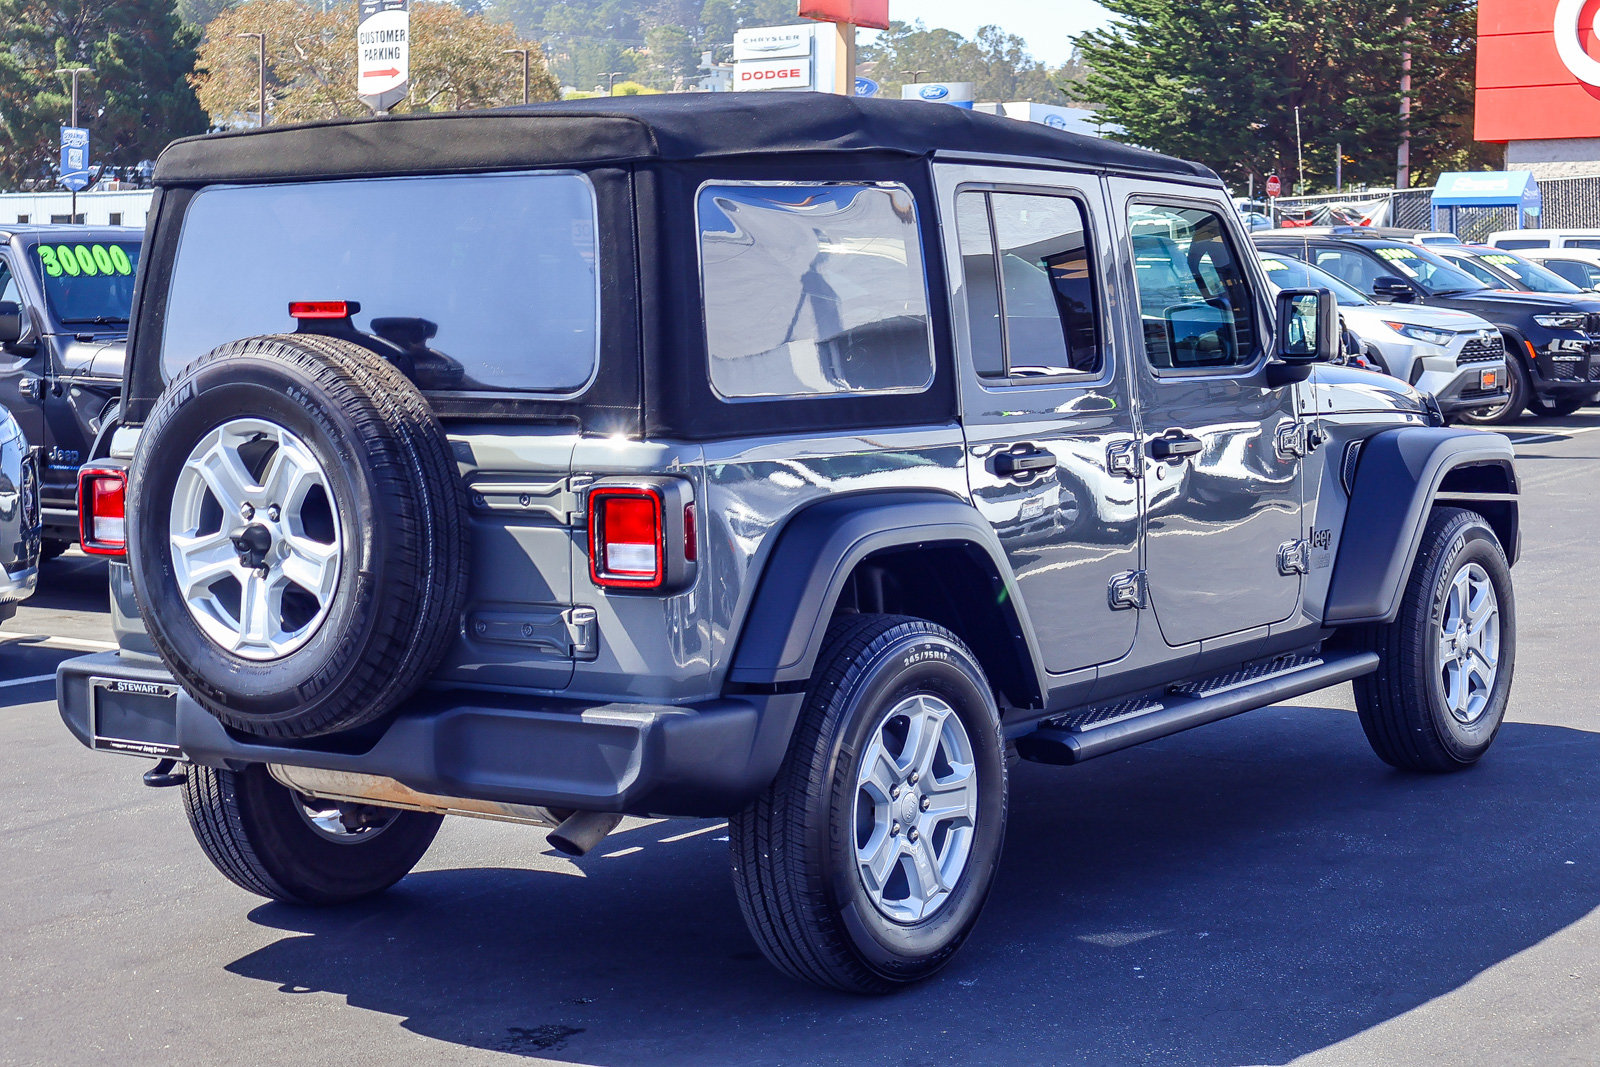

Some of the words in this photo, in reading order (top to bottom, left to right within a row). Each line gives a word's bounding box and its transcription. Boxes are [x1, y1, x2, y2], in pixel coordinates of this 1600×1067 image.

[360, 29, 406, 45] CUSTOMER
[742, 34, 801, 45] CHRYSLER
[364, 46, 401, 61] PARKING
[741, 68, 801, 81] DODGE
[37, 244, 132, 277] 30000
[48, 445, 79, 464] Jeep
[1309, 526, 1332, 551] Jeep
[1435, 536, 1464, 601] MICHELIN
[903, 650, 948, 667] 245/75R17
[117, 681, 159, 694] STEWART
